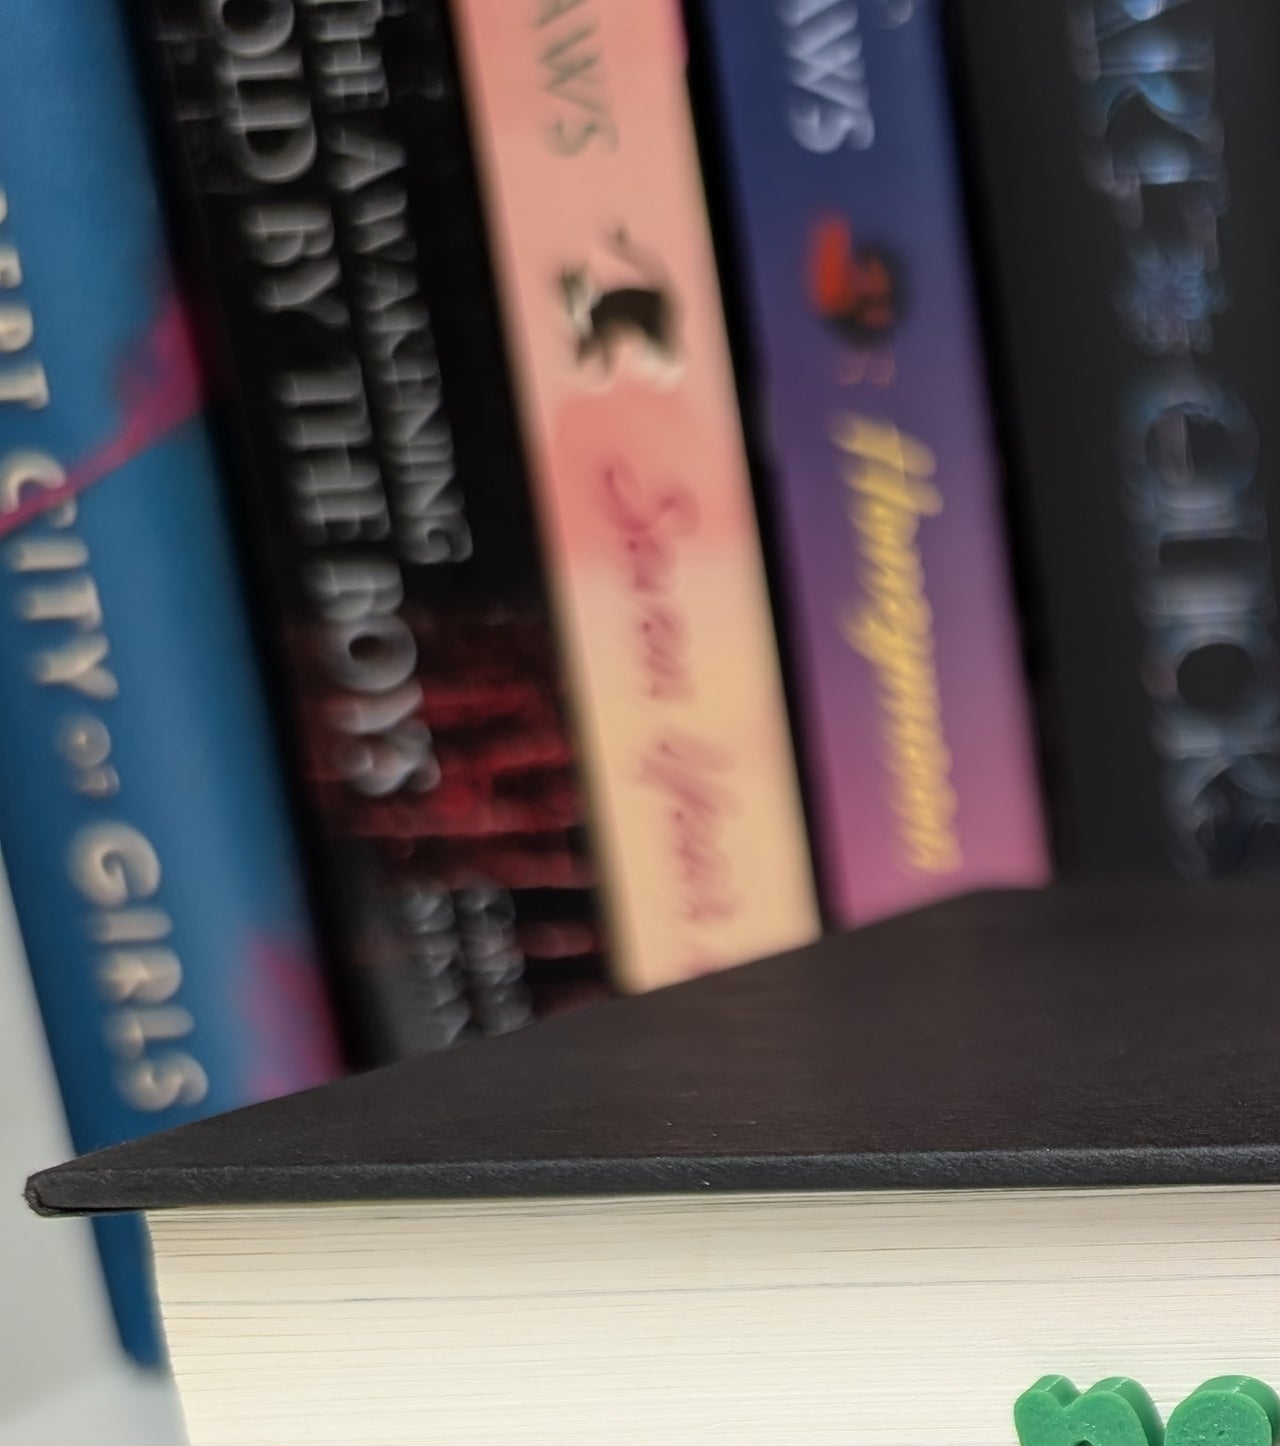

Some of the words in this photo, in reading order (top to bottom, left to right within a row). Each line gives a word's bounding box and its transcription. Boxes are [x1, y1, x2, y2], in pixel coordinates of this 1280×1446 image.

[243, 203, 351, 326] BY
[325, 122, 474, 566] AWAKENING
[277, 365, 393, 542] THE
[0, 448, 118, 699] CITY
[66, 820, 209, 1113] GIRLS
[310, 556, 441, 796] BOYS
